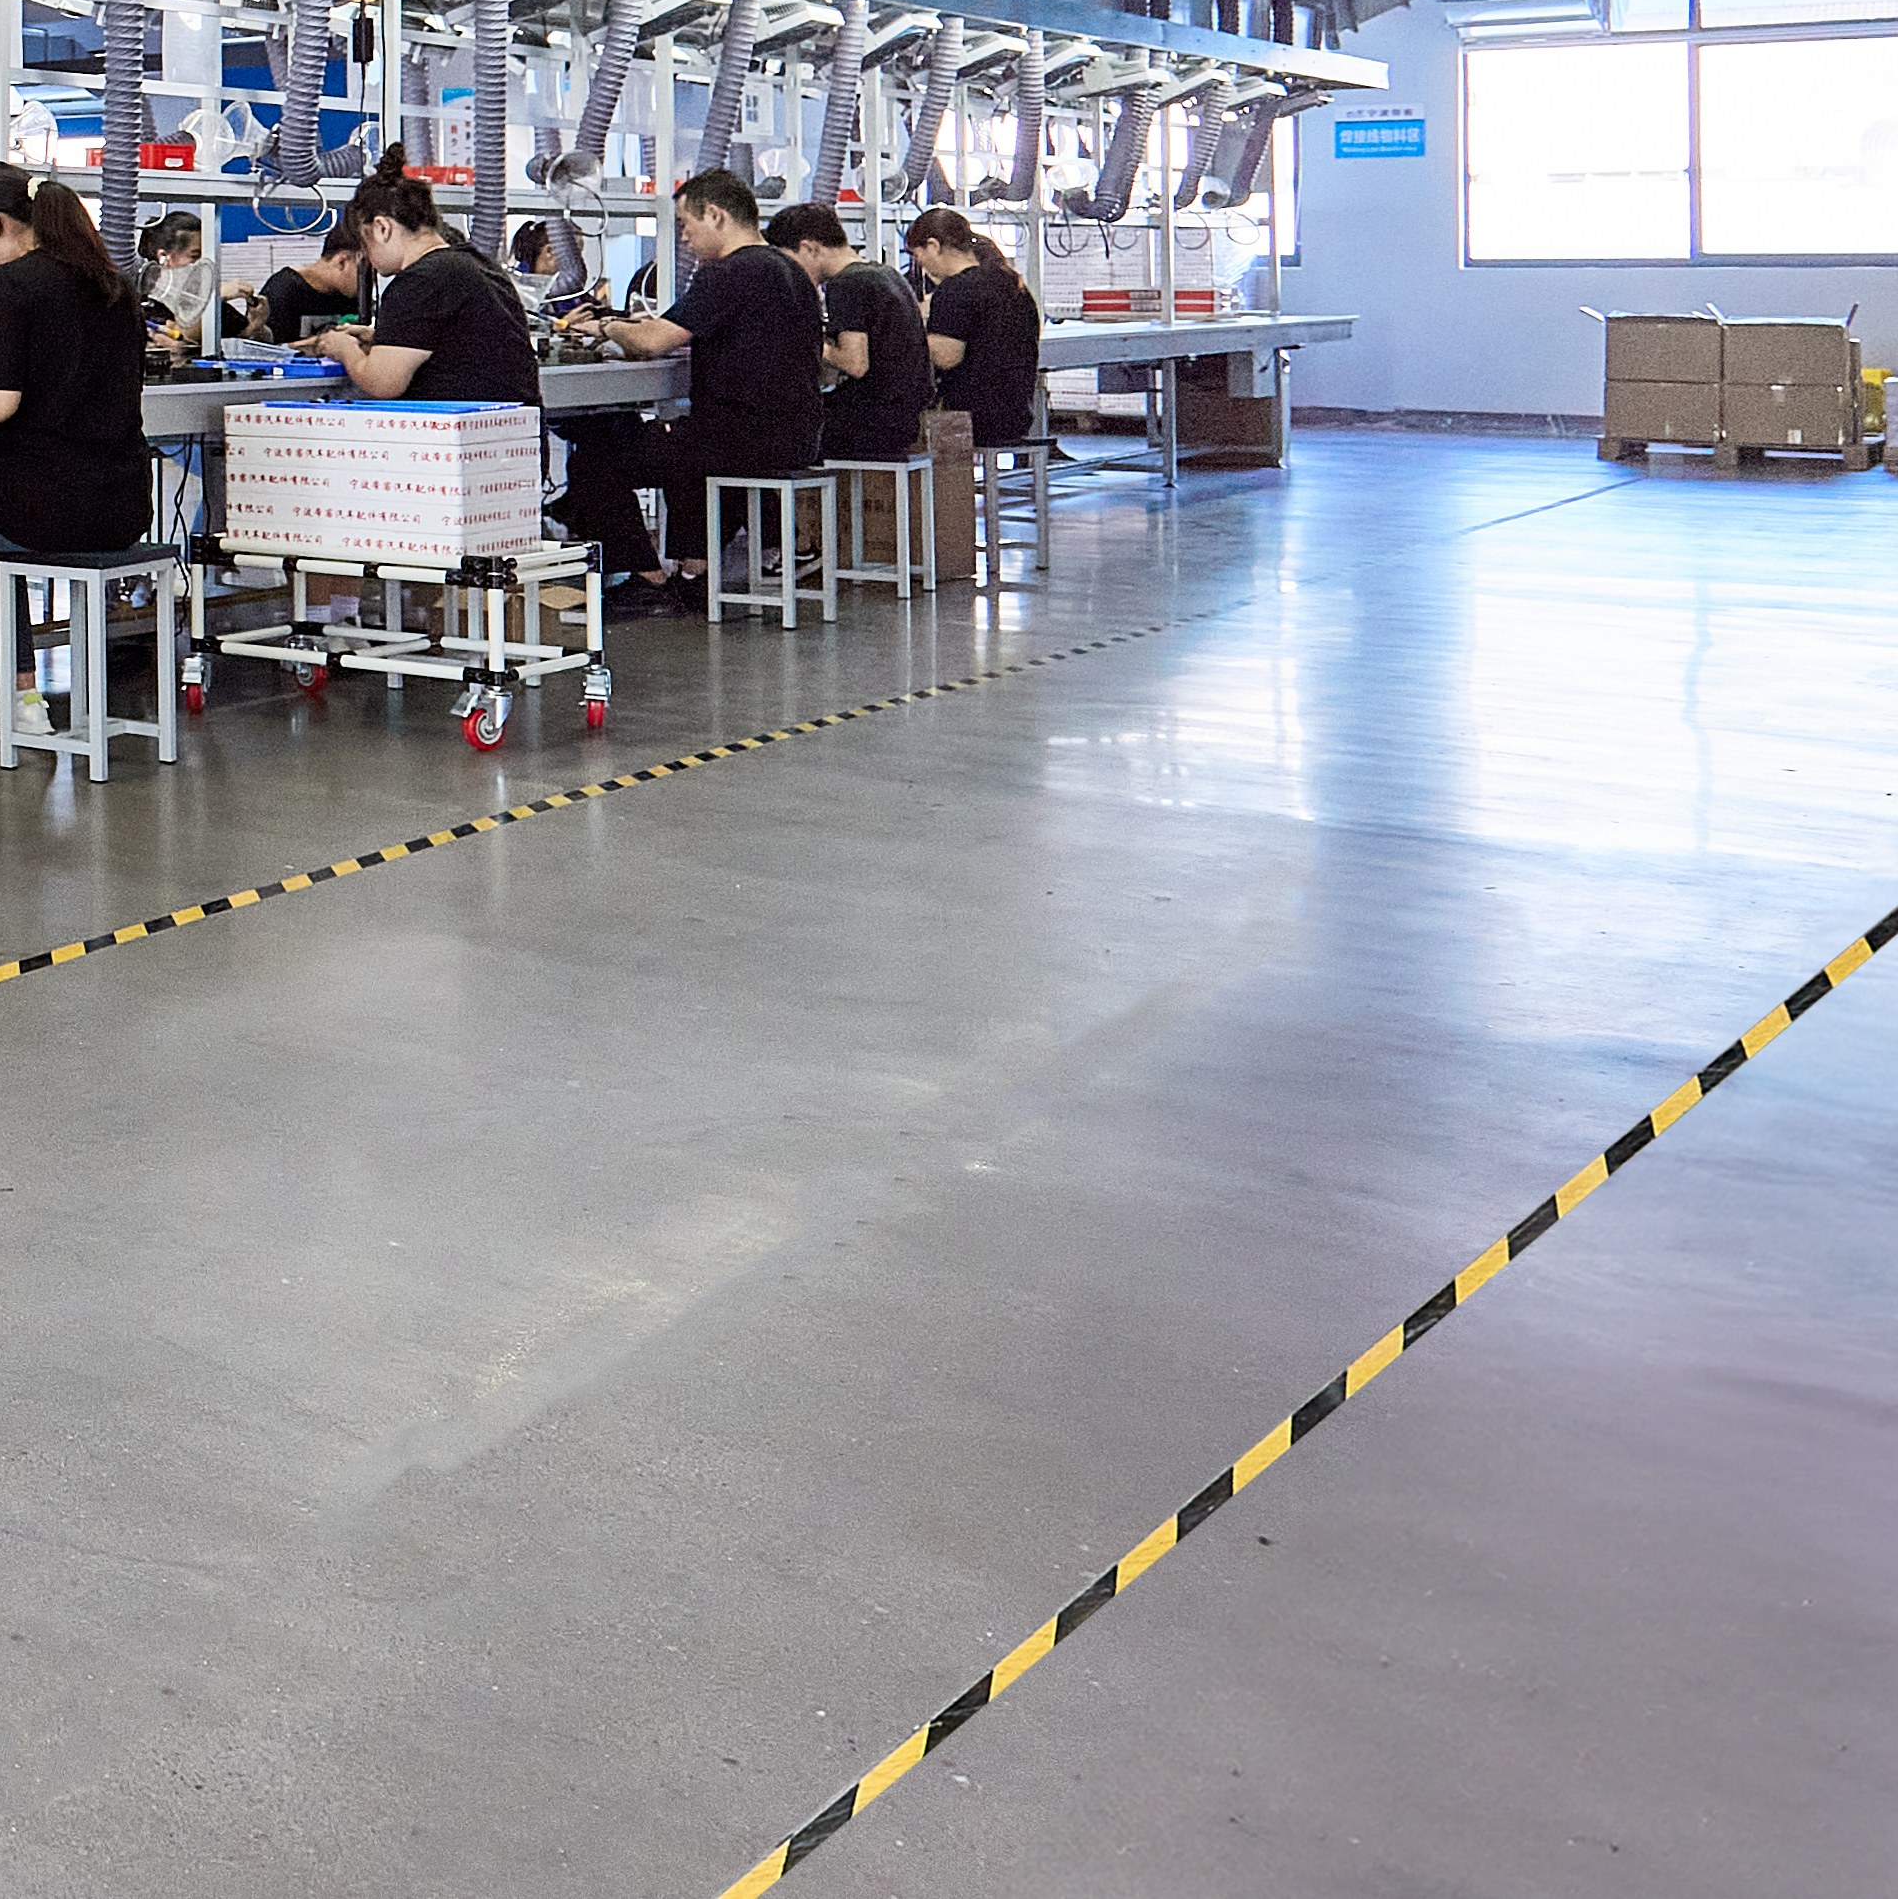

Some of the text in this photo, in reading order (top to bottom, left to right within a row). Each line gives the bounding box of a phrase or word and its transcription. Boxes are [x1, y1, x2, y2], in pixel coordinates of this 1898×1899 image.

[228, 473, 330, 488] 帝客汽车配件有限公司
